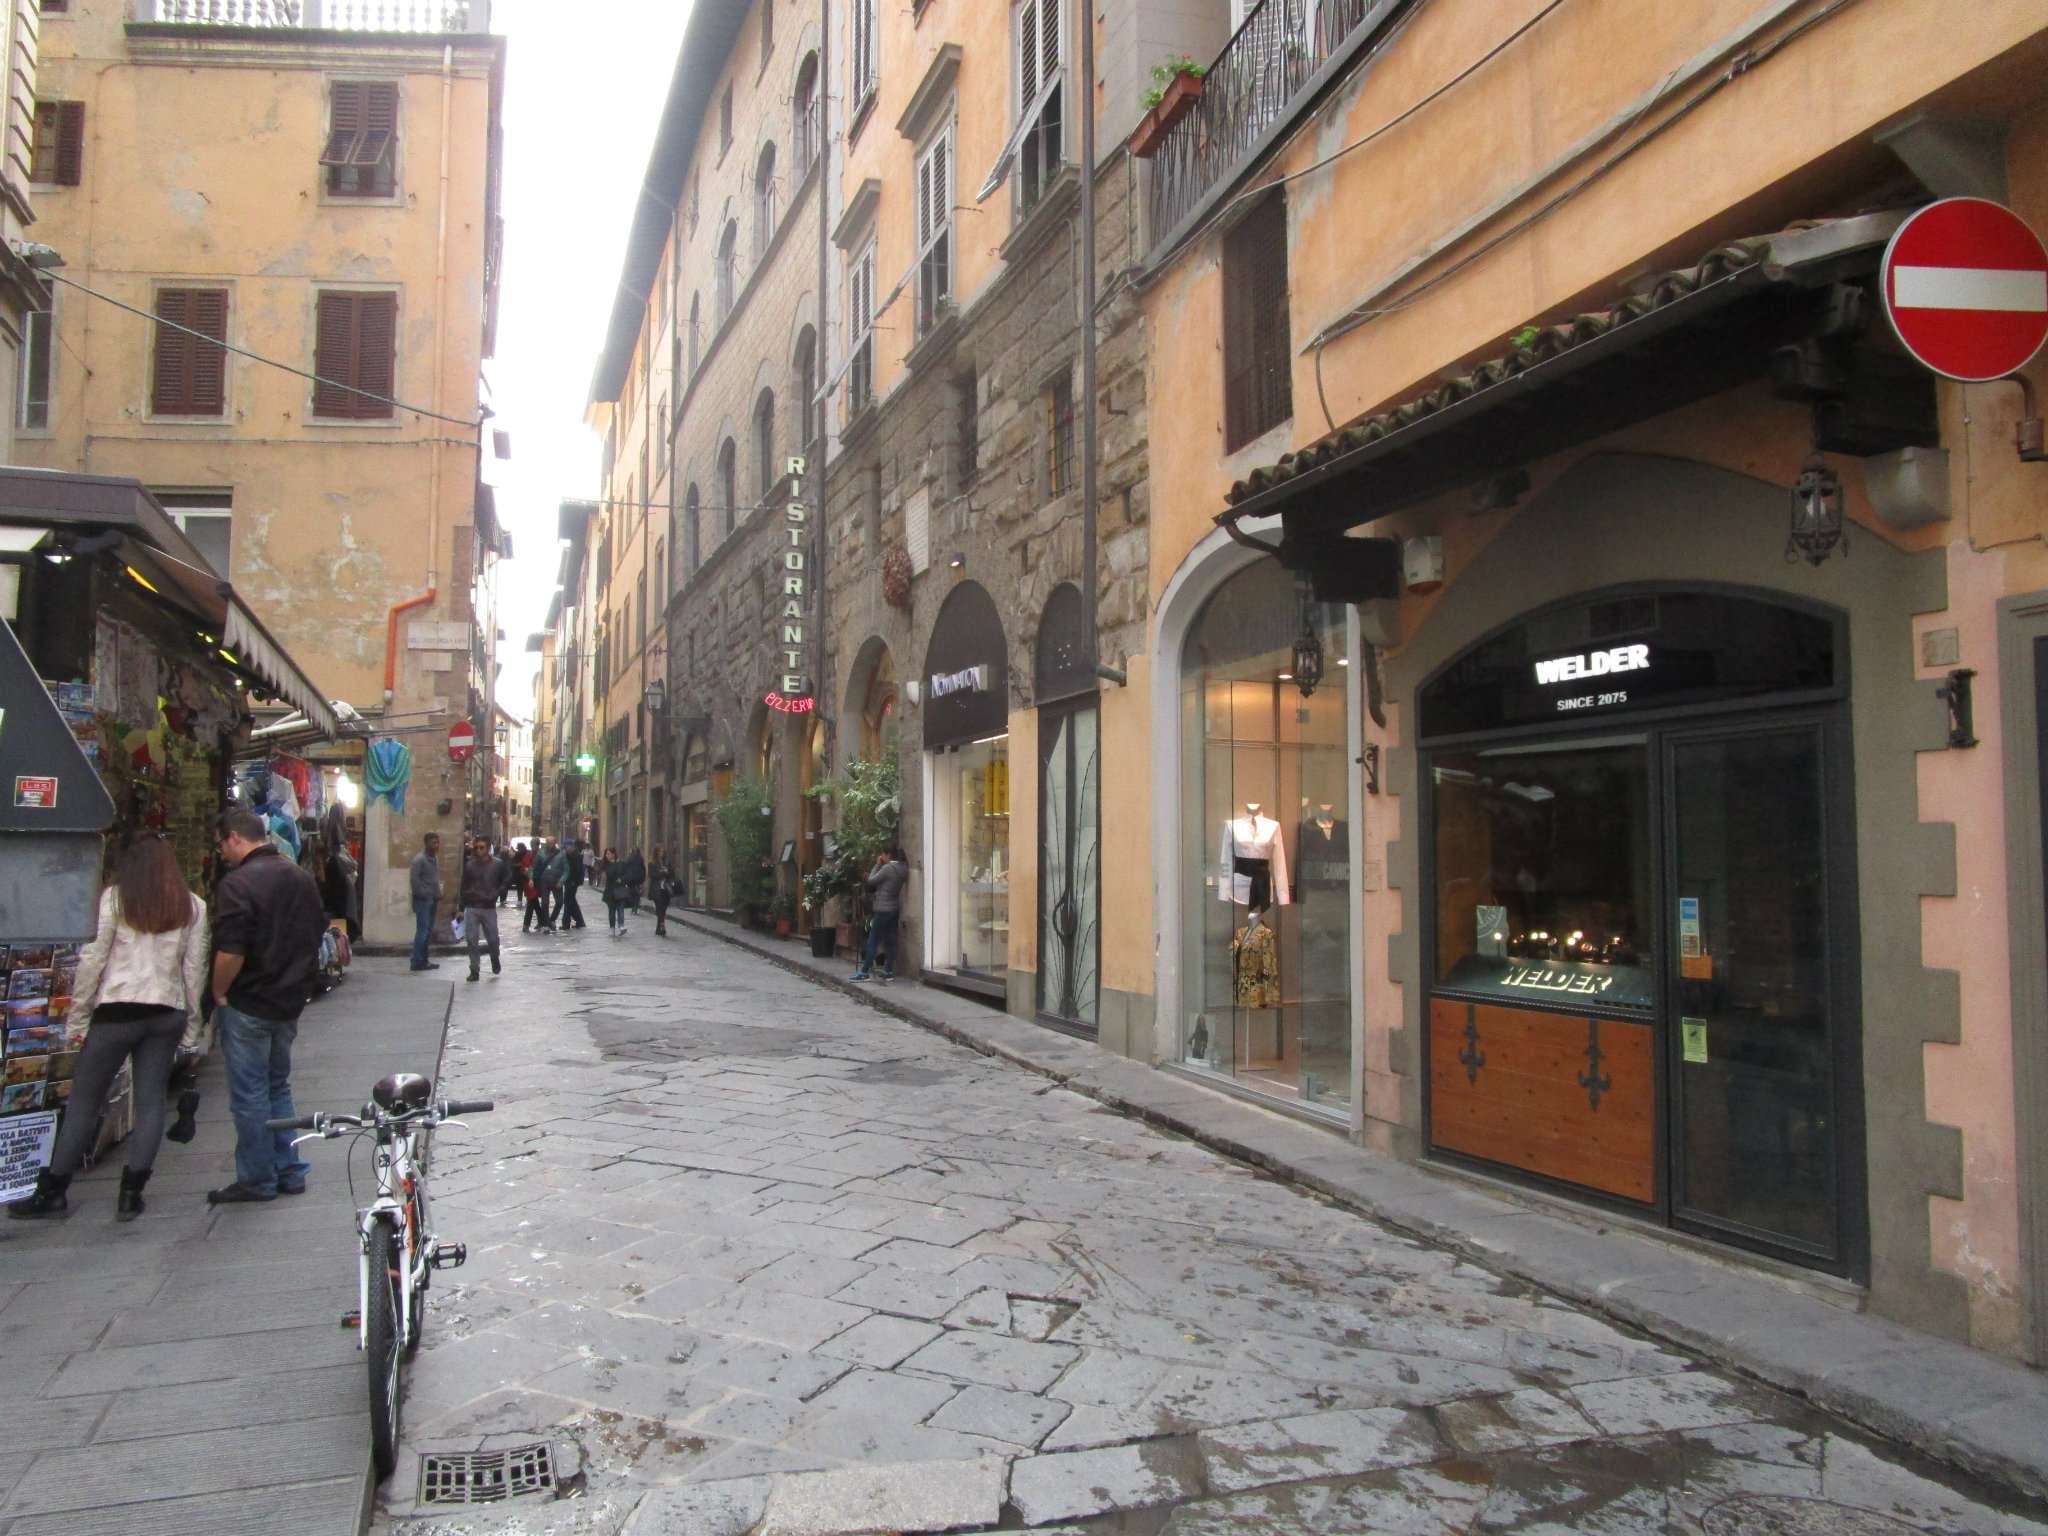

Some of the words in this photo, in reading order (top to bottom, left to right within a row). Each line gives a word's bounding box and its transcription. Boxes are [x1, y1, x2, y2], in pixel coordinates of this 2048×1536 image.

[783, 456, 804, 692] RISTORANTE
[1536, 644, 1650, 684] WELDER
[765, 692, 814, 713] PIZZERIA
[1557, 696, 1594, 711] SINCE
[1598, 691, 1627, 706] 2075
[1500, 966, 1612, 994] WELDER
